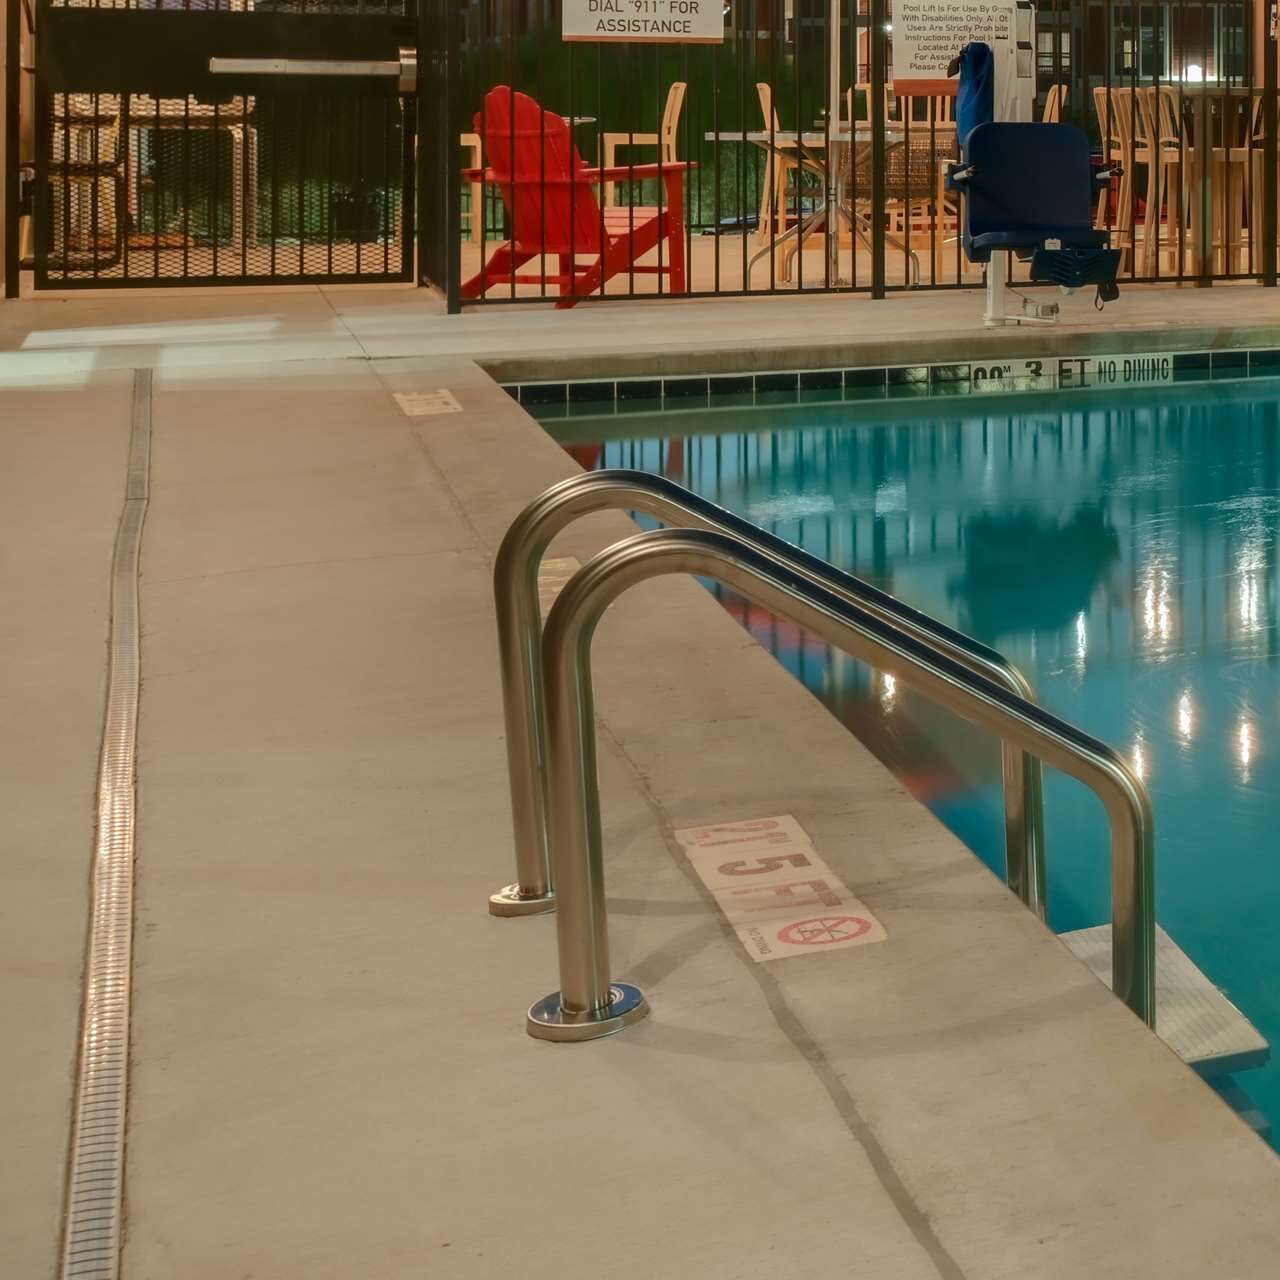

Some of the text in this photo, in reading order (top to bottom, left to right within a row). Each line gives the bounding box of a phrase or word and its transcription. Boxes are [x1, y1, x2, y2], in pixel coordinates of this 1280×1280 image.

[588, 0, 624, 12] DIAL
[670, 1, 699, 14] FOR
[903, 4, 921, 12] Pool
[923, 4, 936, 12] Lift
[938, 4, 944, 12] Is
[947, 4, 960, 12] For
[962, 4, 977, 12] Use
[979, 4, 990, 14] By
[596, 19, 692, 33] ASSISTANCE
[945, 24, 972, 33] Strictly
[905, 33, 951, 41] Instructions
[953, 33, 967, 41] For
[969, 33, 986, 41] Pool
[917, 43, 949, 51] Located
[950, 43, 959, 51] At
[914, 53, 928, 61] For
[909, 62, 936, 71] Please
[717, 853, 813, 876] 5
